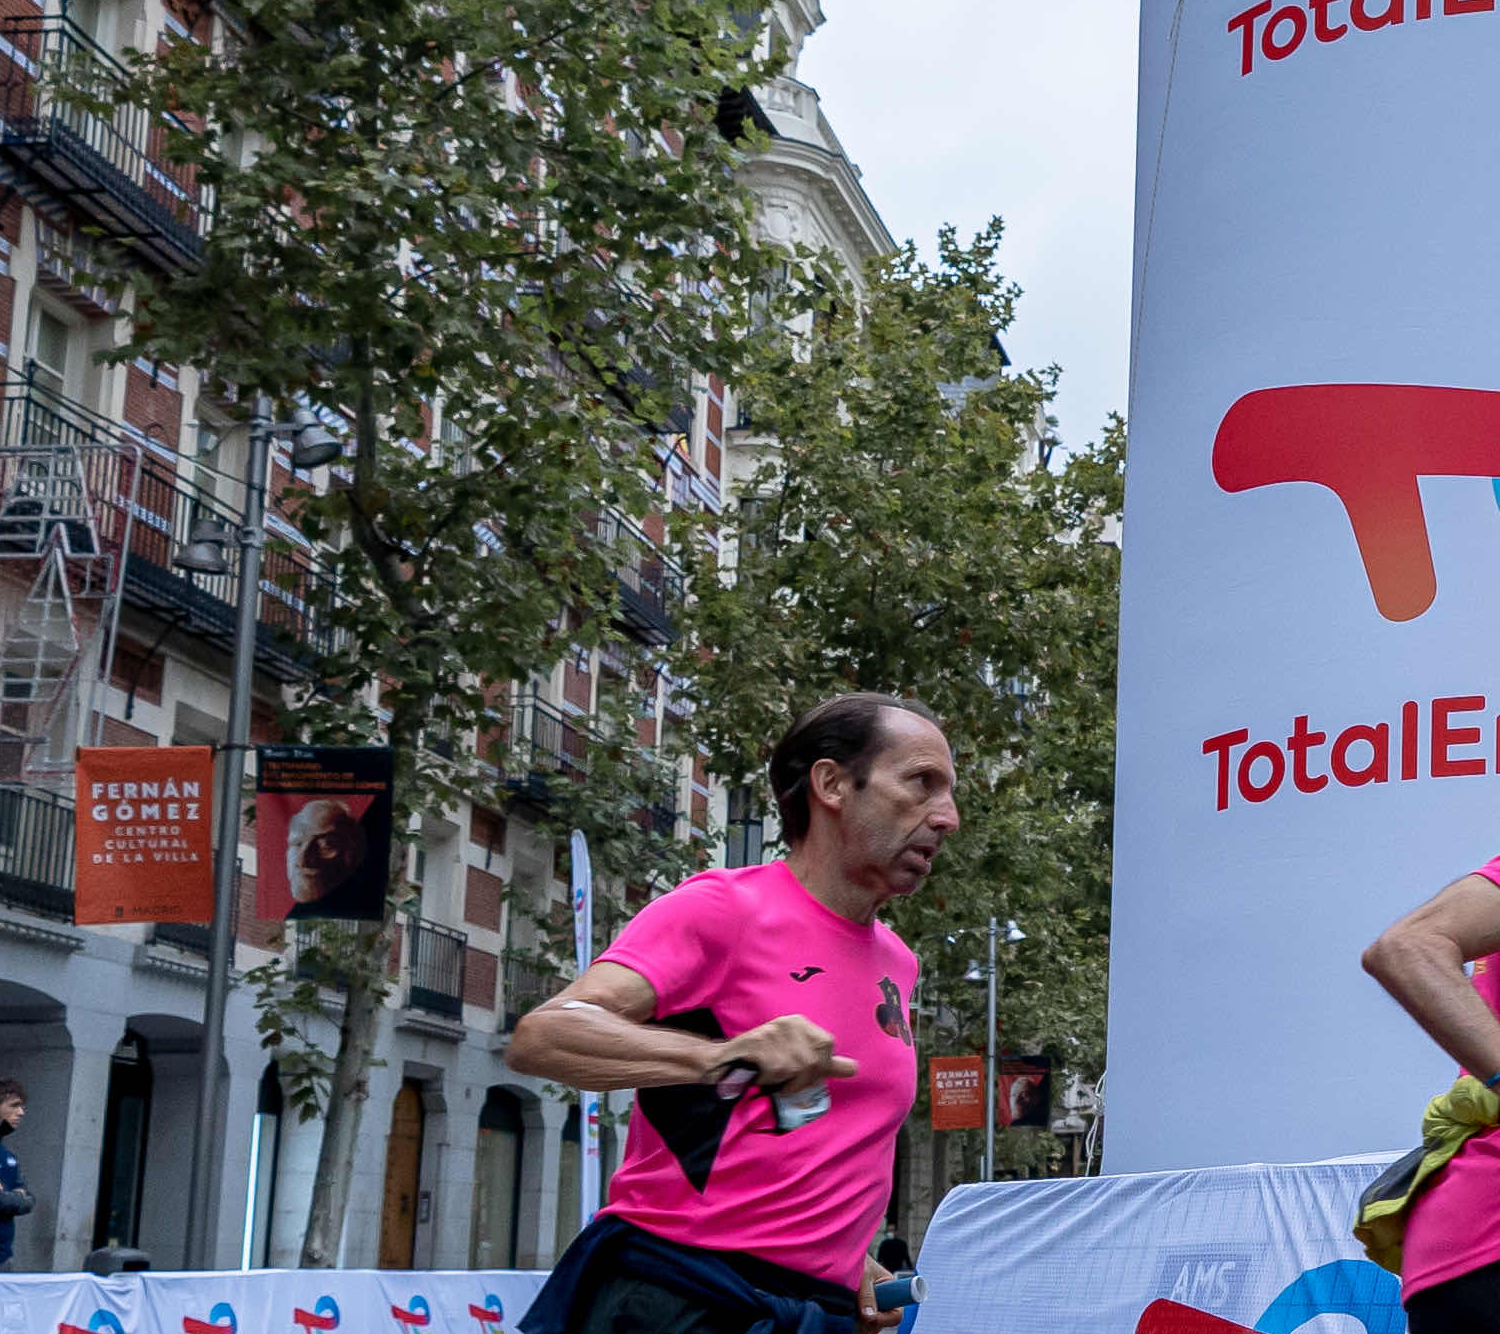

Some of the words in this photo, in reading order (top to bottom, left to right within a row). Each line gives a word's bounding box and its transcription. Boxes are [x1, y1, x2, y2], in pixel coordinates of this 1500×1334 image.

[92, 777, 200, 799] FERNÁN
[92, 799, 199, 821] GÓMEZ
[114, 825, 181, 836] CENTRO
[105, 838, 188, 850] CULTURAL
